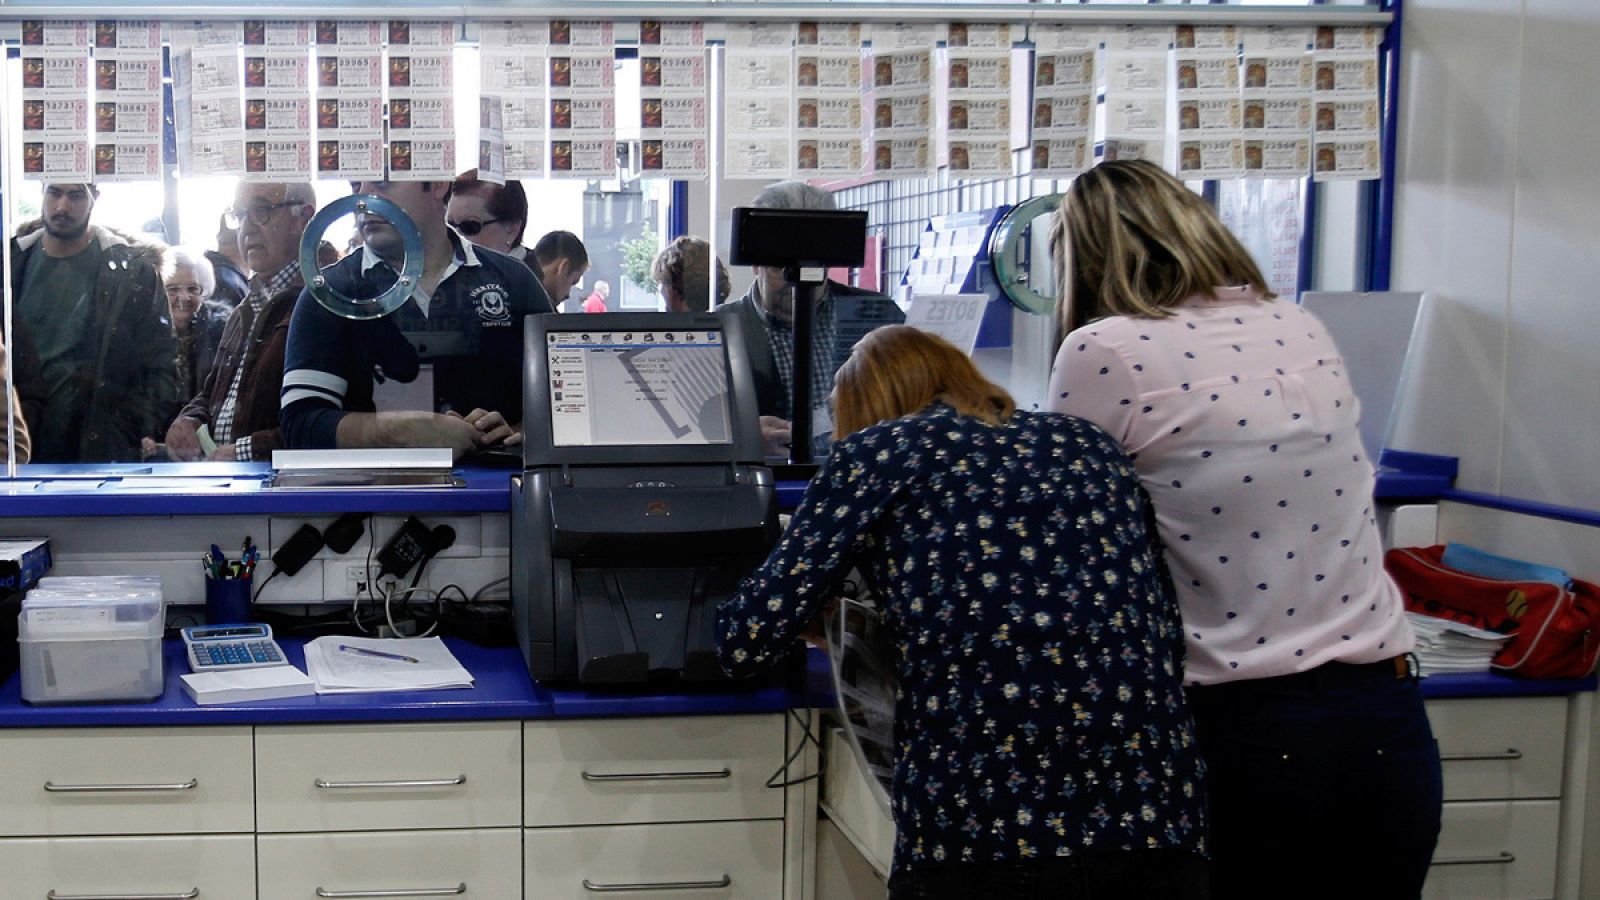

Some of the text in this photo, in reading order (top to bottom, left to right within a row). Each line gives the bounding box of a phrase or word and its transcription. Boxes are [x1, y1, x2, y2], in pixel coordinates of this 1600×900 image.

[46, 59, 75, 68] 13731
[46, 100, 75, 109] 13731
[46, 143, 75, 152] 13731
